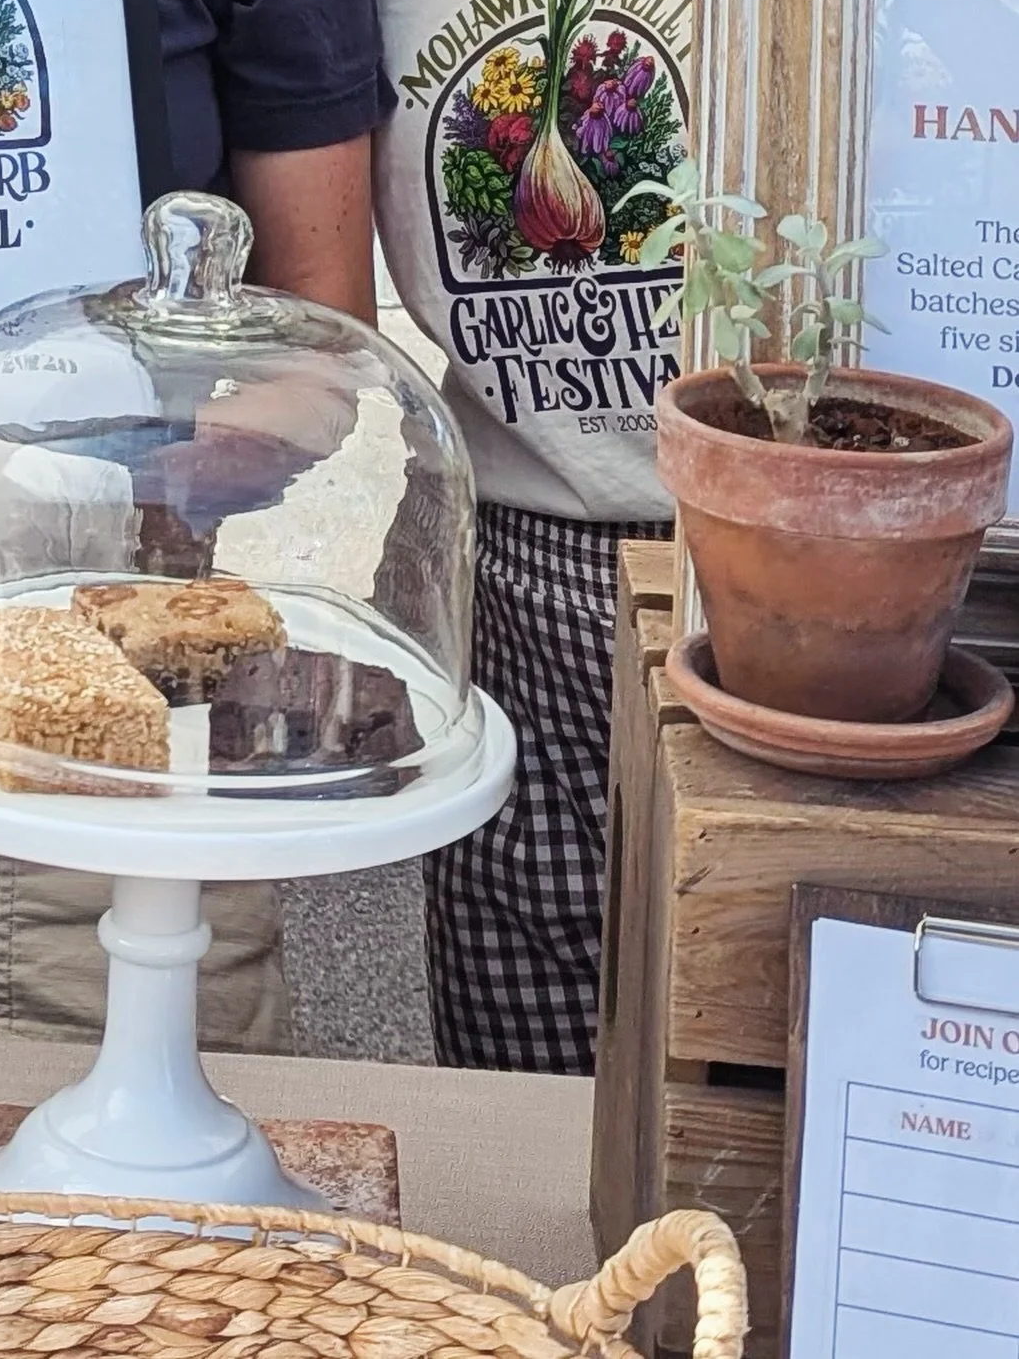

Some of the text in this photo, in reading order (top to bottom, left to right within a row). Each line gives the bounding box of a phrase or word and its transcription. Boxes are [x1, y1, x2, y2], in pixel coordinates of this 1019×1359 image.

[897, 252, 983, 279] Salted
[910, 288, 1019, 317] batches
[450, 292, 575, 365] GARLIC
[940, 326, 990, 351] five
[617, 414, 658, 432] 2003
[920, 1018, 995, 1050] JOIN
[919, 1049, 950, 1072] for
[900, 1111, 972, 1140] NAME
